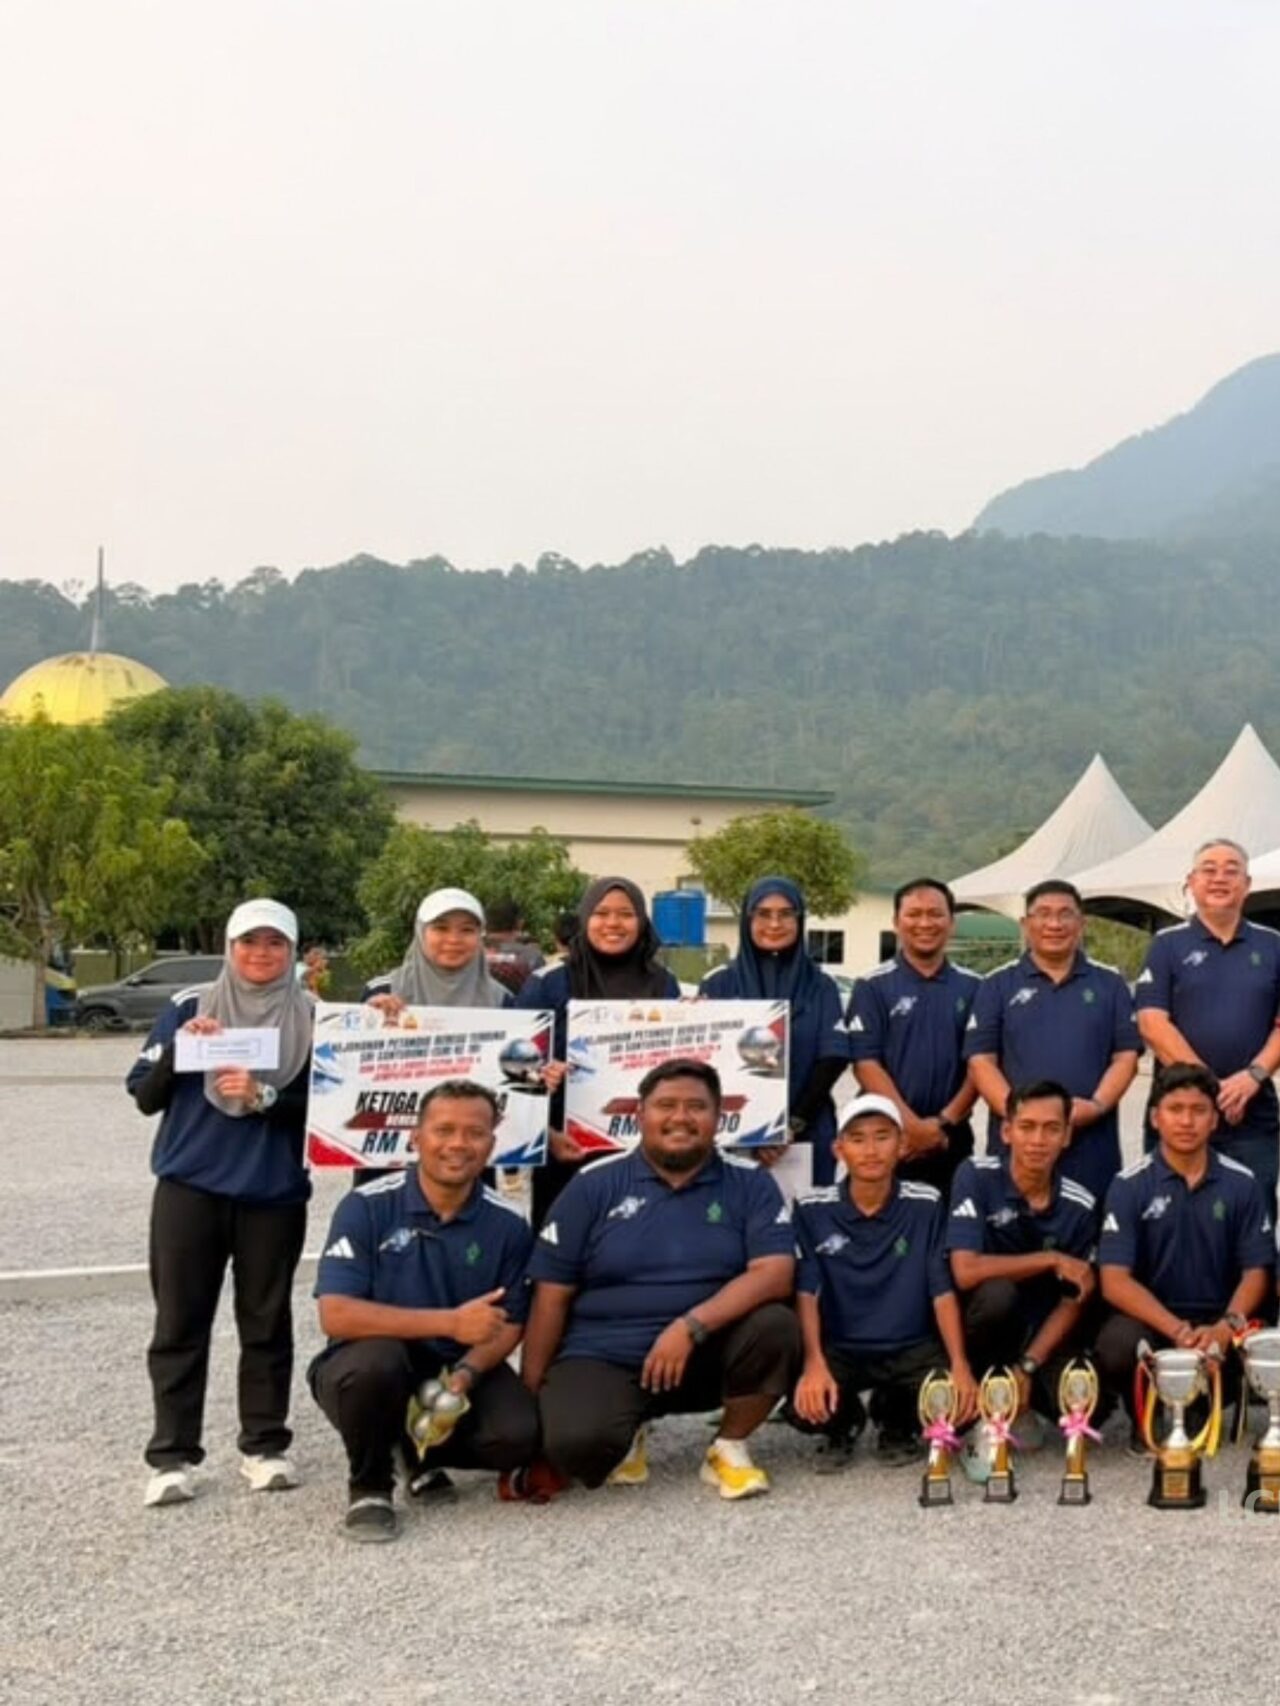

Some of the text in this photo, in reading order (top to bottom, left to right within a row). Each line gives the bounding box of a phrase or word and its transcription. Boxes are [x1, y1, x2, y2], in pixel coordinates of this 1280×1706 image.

[355, 1091, 419, 1113] KETIGA
[609, 1115, 639, 1137] RM
[362, 1131, 400, 1153] RM
